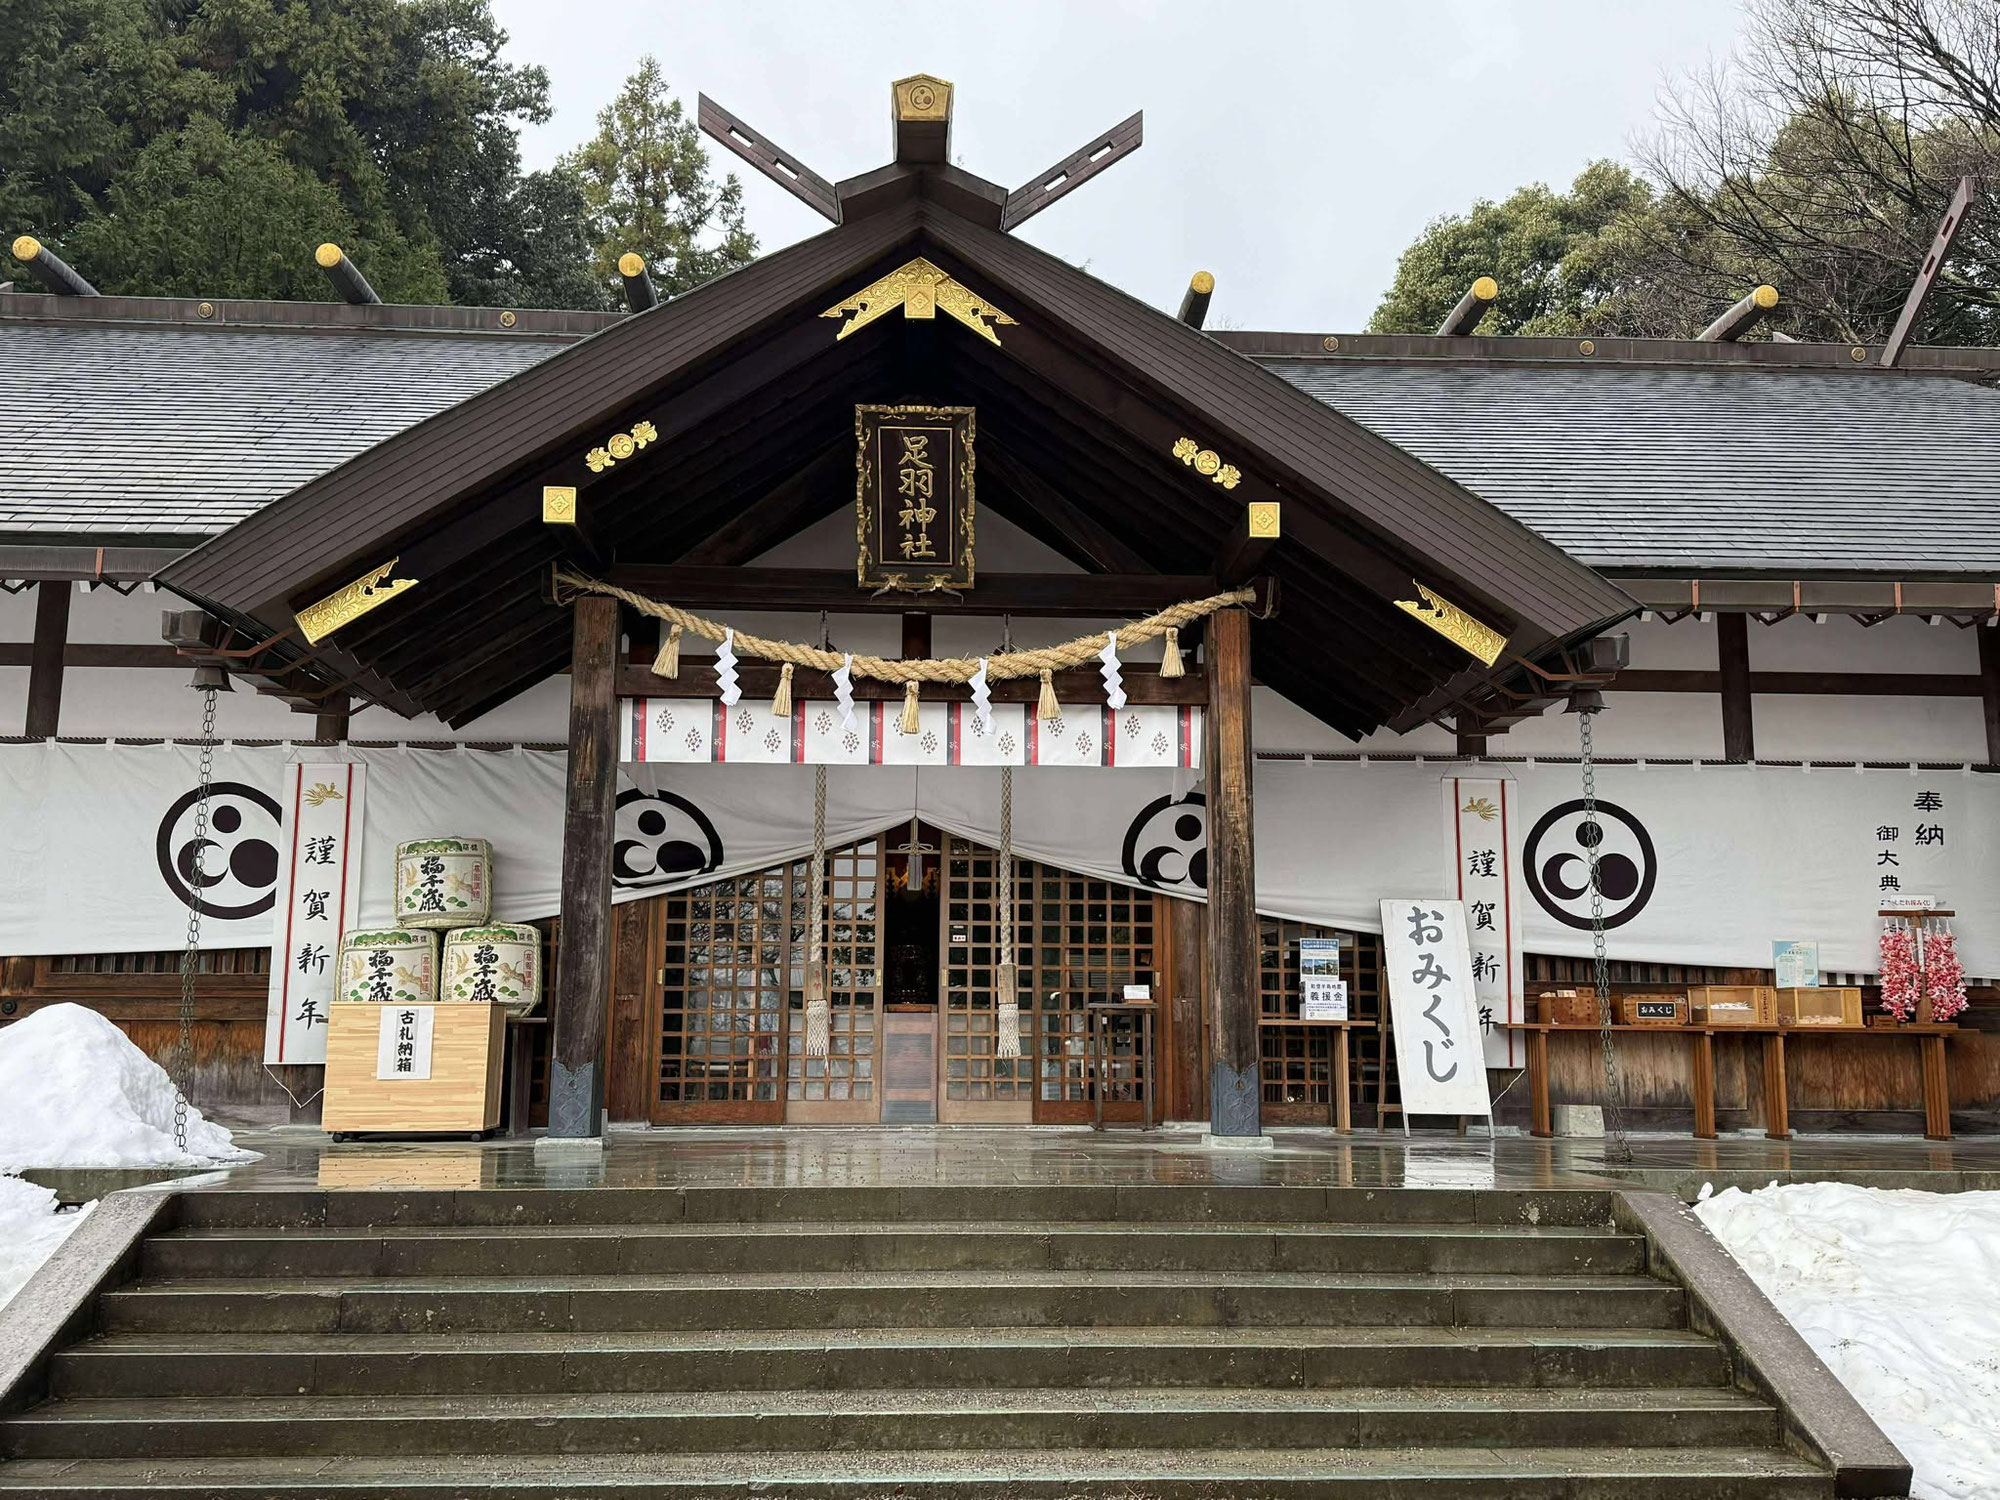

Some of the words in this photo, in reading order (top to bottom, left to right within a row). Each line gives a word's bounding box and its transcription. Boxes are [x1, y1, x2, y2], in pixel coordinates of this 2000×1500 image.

[898, 435, 938, 560] 足羽神社
[1913, 790, 1944, 846] 奉納
[418, 855, 447, 912] 福千歳
[295, 835, 337, 1031] 謹賀新年
[1467, 849, 1501, 1036] 謹賀新年
[1310, 991, 1344, 1001] 義援金
[1407, 905, 1458, 1083] おみくじ
[1640, 1006, 1673, 1015] おみくじ
[397, 1010, 415, 1073] 古札納箱
